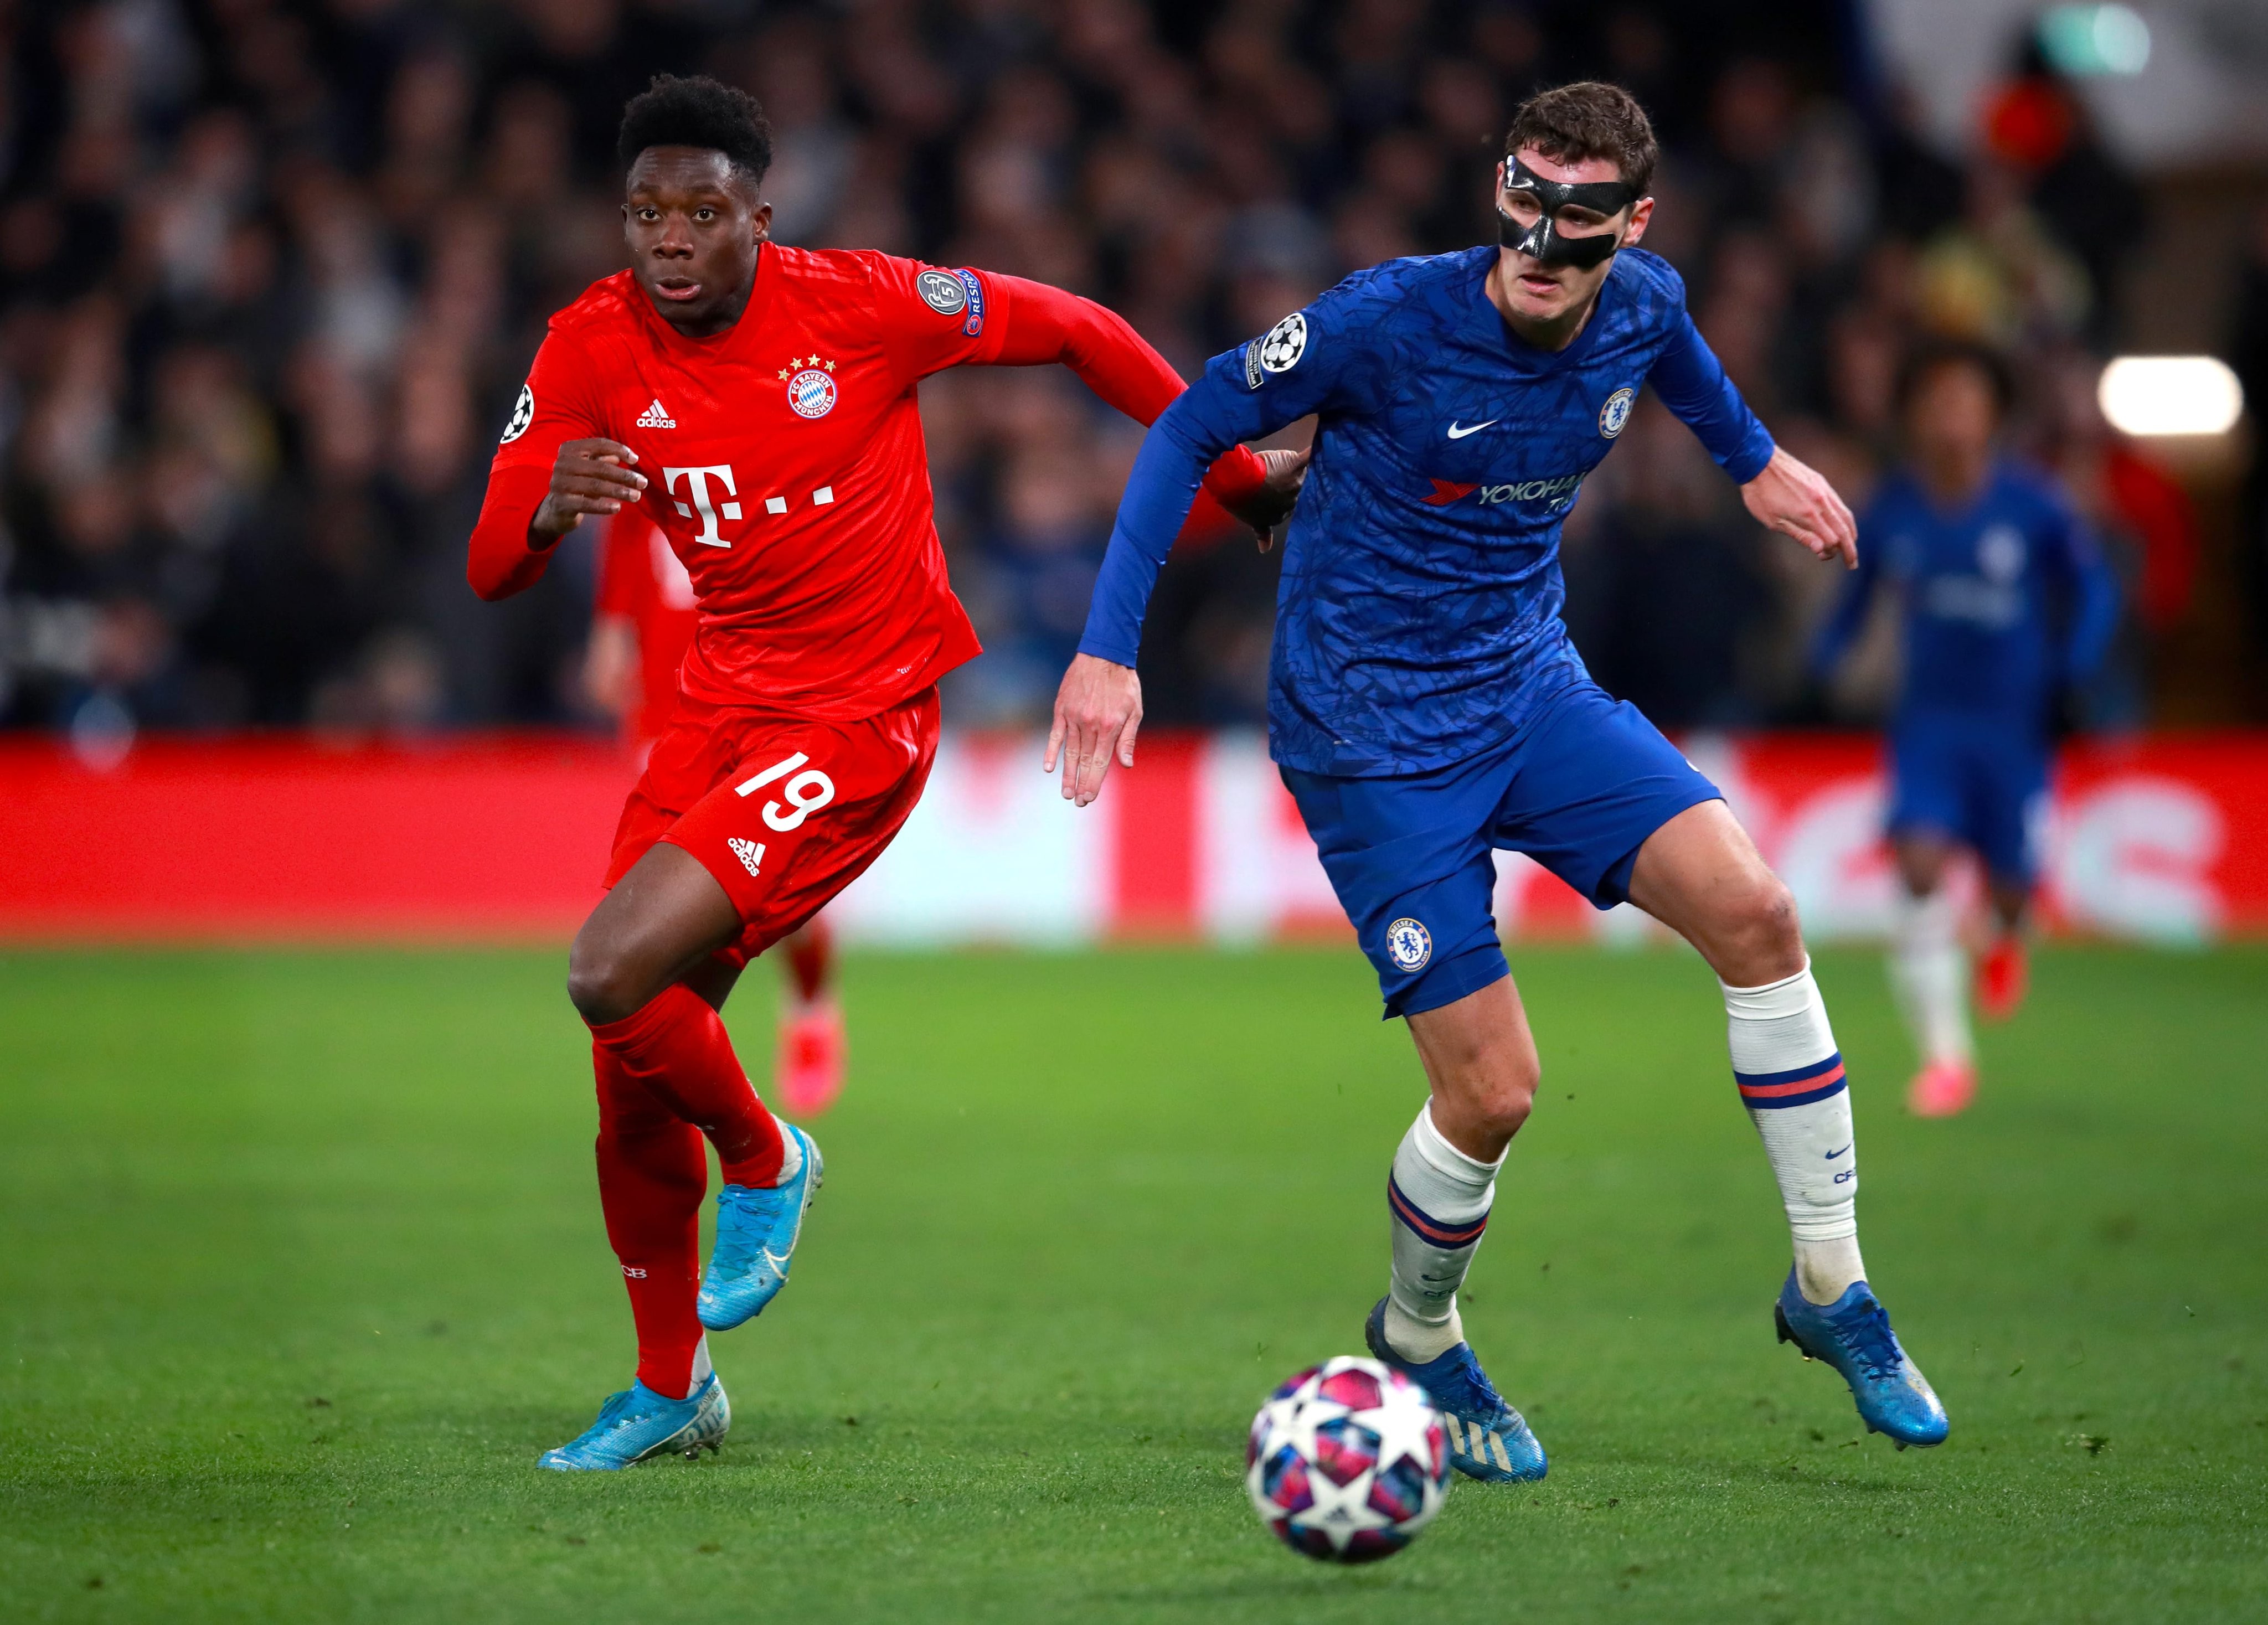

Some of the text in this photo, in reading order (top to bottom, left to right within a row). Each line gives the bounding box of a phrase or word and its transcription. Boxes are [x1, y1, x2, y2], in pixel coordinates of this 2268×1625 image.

[941, 286, 954, 297] 5
[791, 373, 831, 394] FC BAYERN
[636, 416, 676, 429] adidas
[734, 751, 835, 832] 19
[727, 837, 760, 877] adidas
[1389, 920, 1413, 939] CHELSEA
